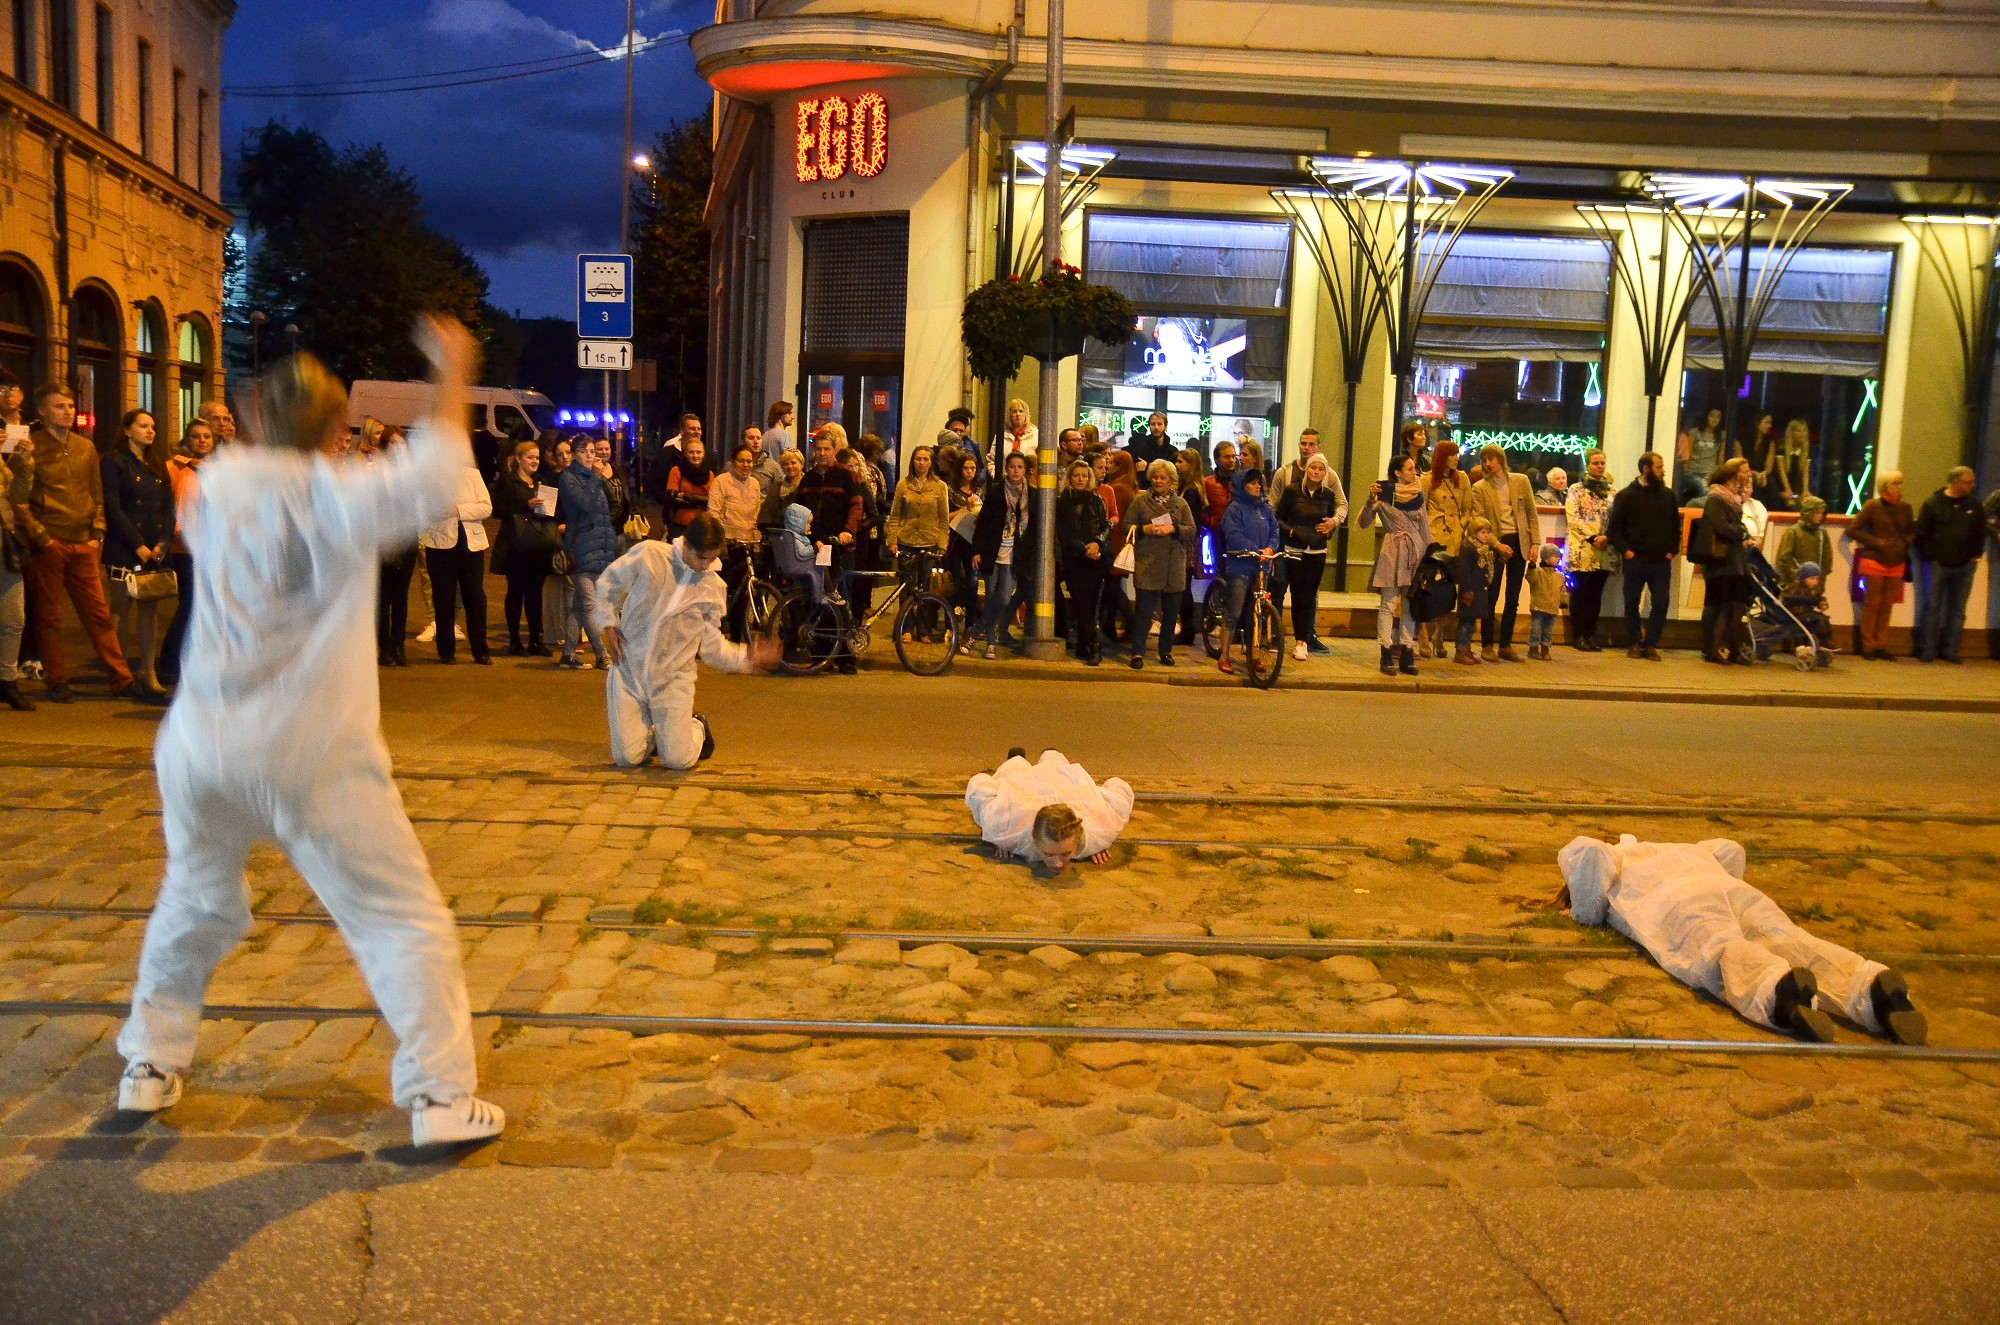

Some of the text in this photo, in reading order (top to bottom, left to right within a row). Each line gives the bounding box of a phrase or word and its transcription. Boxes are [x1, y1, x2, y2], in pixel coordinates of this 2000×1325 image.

[797, 92, 888, 182] EGO
[822, 190, 855, 199] CLUB
[602, 311, 608, 322] 3
[595, 353, 605, 363] 15
[821, 394, 831, 404] EGO
[874, 395, 885, 404] EGO
[1105, 412, 1127, 432] EGO
